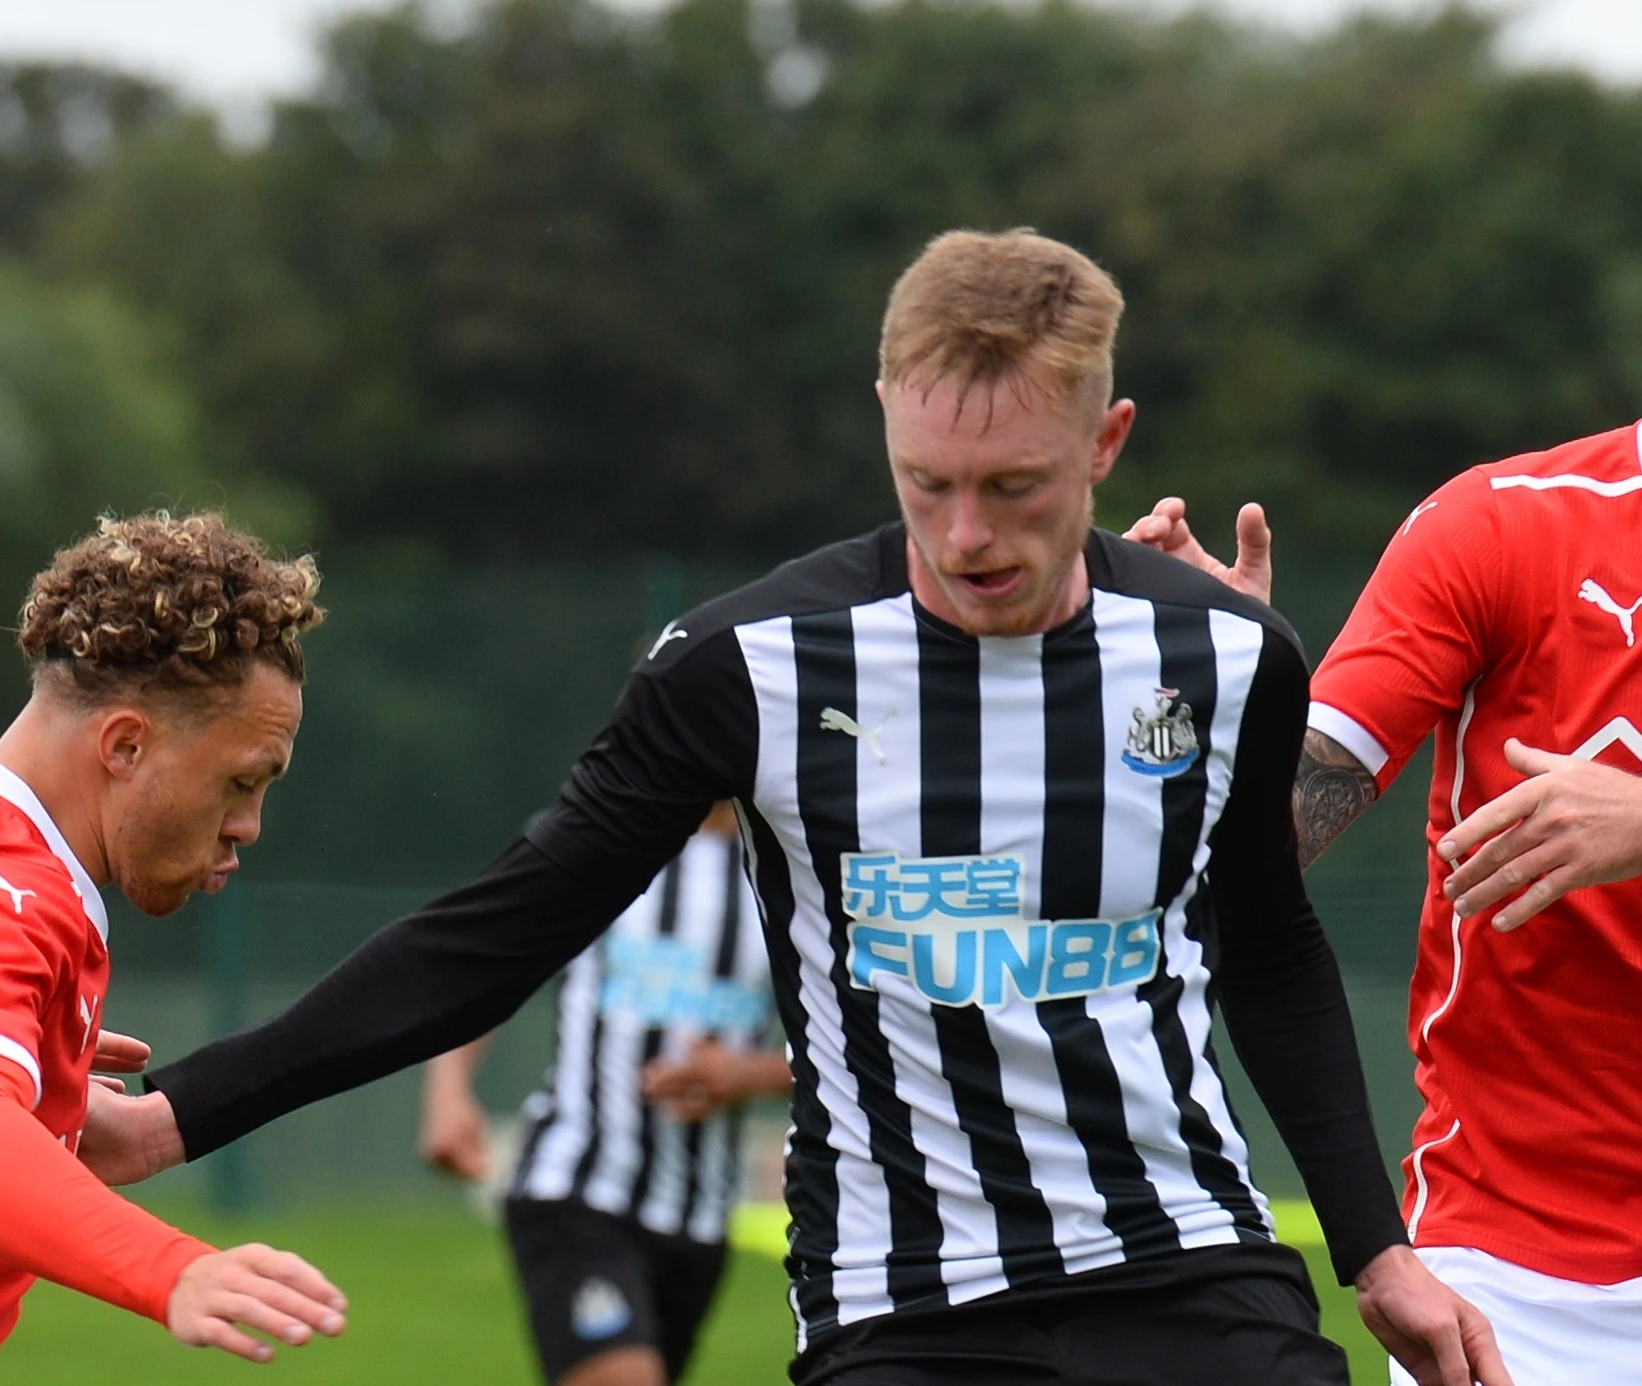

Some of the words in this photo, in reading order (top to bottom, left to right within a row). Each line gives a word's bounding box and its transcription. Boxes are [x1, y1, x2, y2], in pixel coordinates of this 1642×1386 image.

[846, 855, 1021, 922] 乐天堂
[851, 911, 1158, 1006] FUN88
